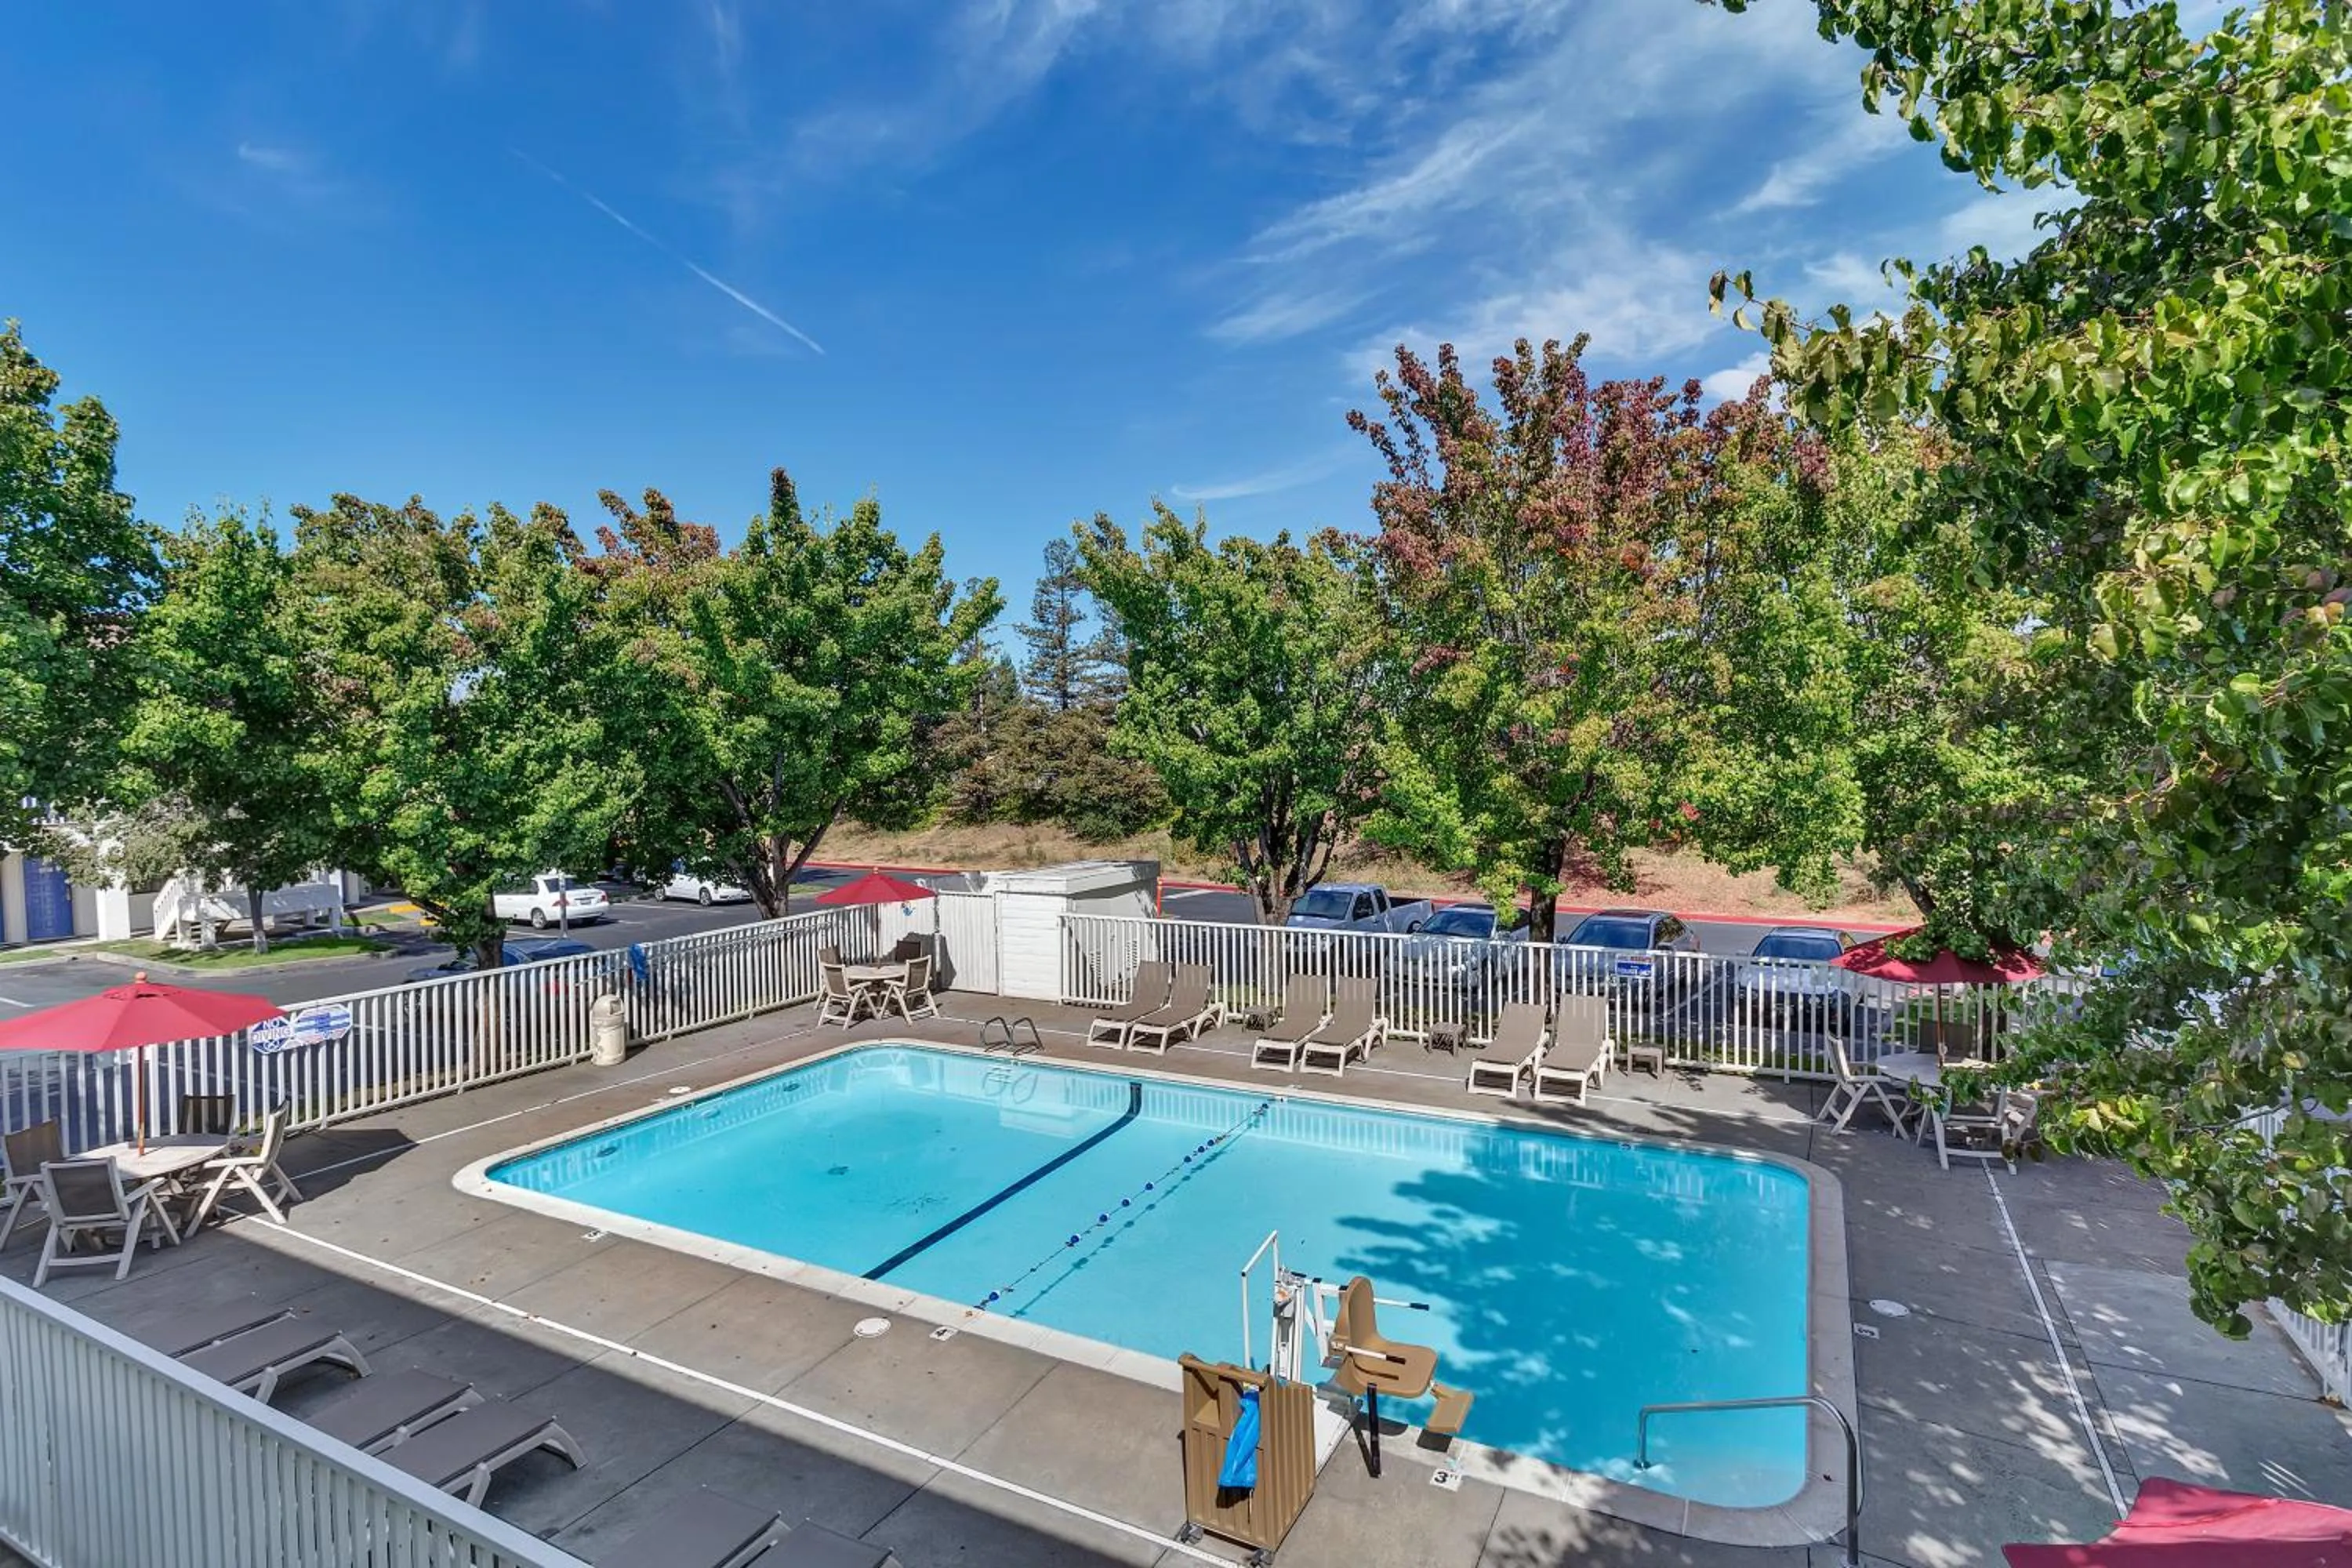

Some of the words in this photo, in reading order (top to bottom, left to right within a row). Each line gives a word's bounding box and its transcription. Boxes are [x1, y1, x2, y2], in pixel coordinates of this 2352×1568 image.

[263, 1019, 280, 1029] NO
[251, 1027, 291, 1042] DIVING
[1434, 1471, 1448, 1483] 3
